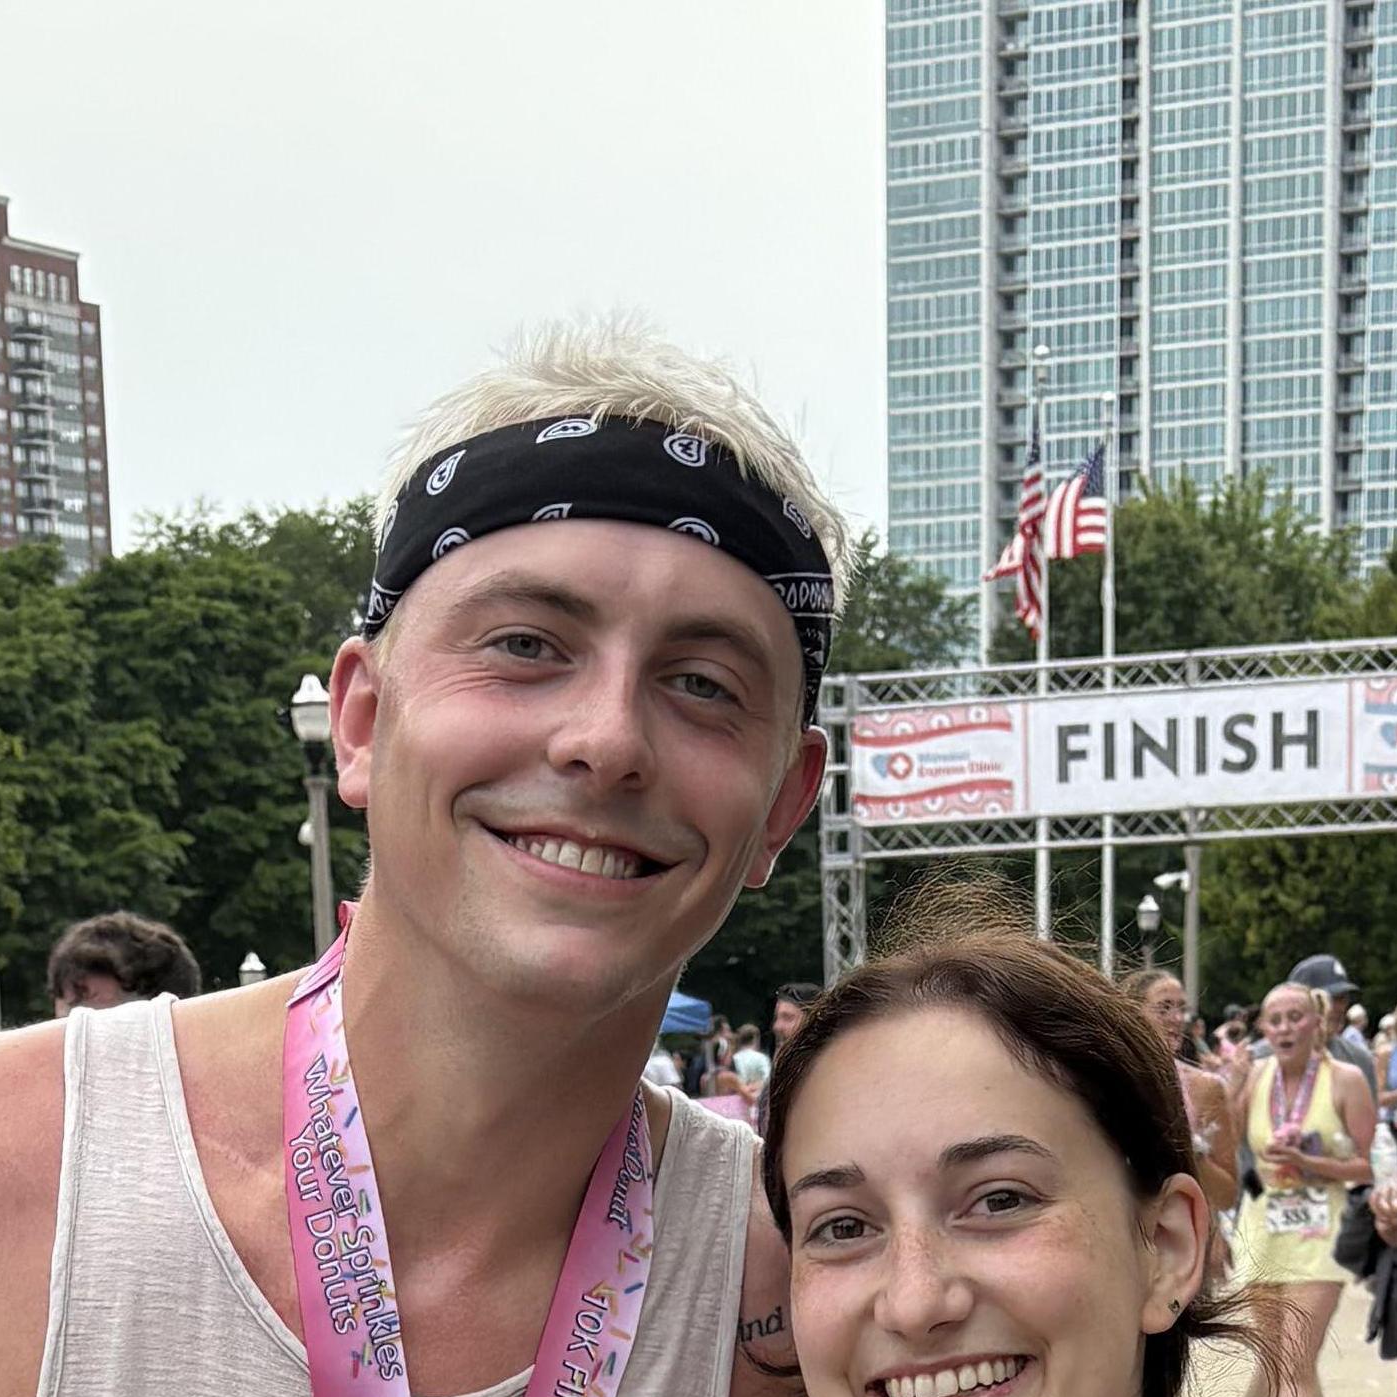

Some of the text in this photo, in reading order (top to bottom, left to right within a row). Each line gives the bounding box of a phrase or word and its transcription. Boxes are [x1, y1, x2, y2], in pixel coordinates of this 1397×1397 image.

[1057, 709, 1319, 783] FINISH
[288, 1124, 357, 1335] Your Donuts
[304, 1052, 403, 1381] Whatever Sprinkles
[566, 1293, 608, 1361] 10K
